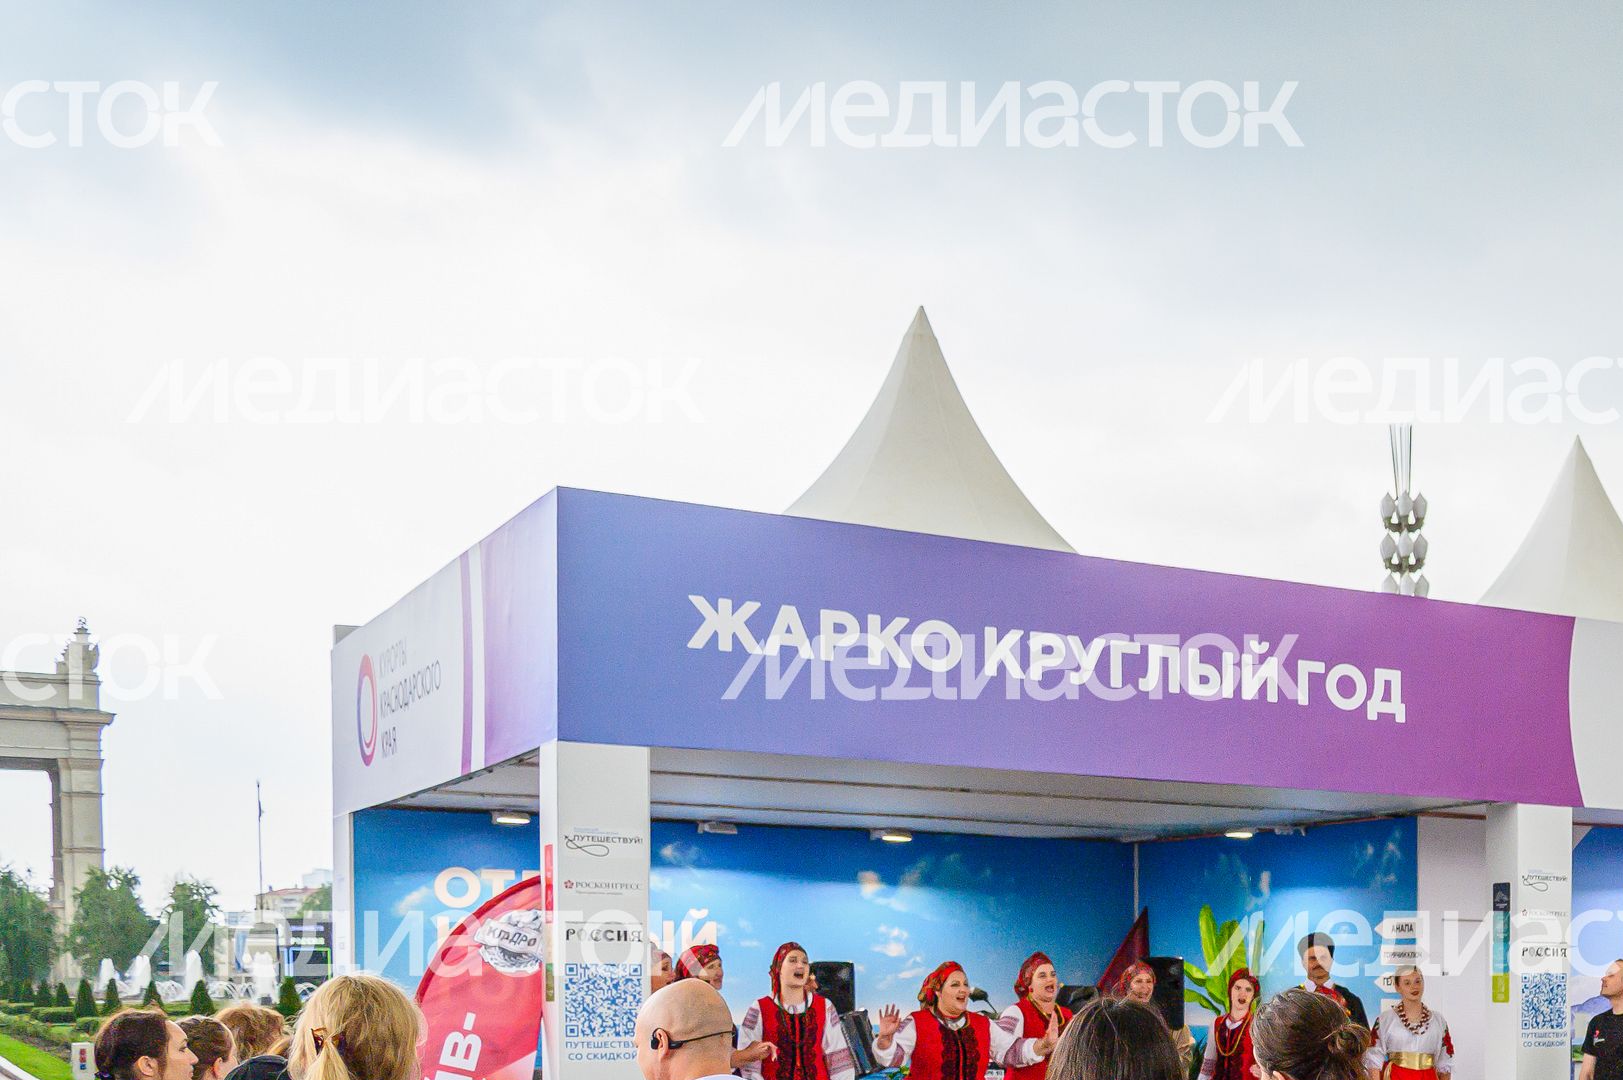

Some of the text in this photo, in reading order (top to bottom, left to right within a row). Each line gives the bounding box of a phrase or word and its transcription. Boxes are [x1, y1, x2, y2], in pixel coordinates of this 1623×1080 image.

[687, 594, 1406, 723] ЖАРКО КРУГЛЫЙ ГОД
[380, 660, 442, 718] КРАСНОДАРСКОГО
[381, 726, 397, 758] КРАЯ
[576, 881, 643, 891] РОСКОНГРЕСС
[566, 928, 642, 942] РОССИЯ
[1391, 923, 1414, 933] АНАПА
[568, 1053, 581, 1061] СО
